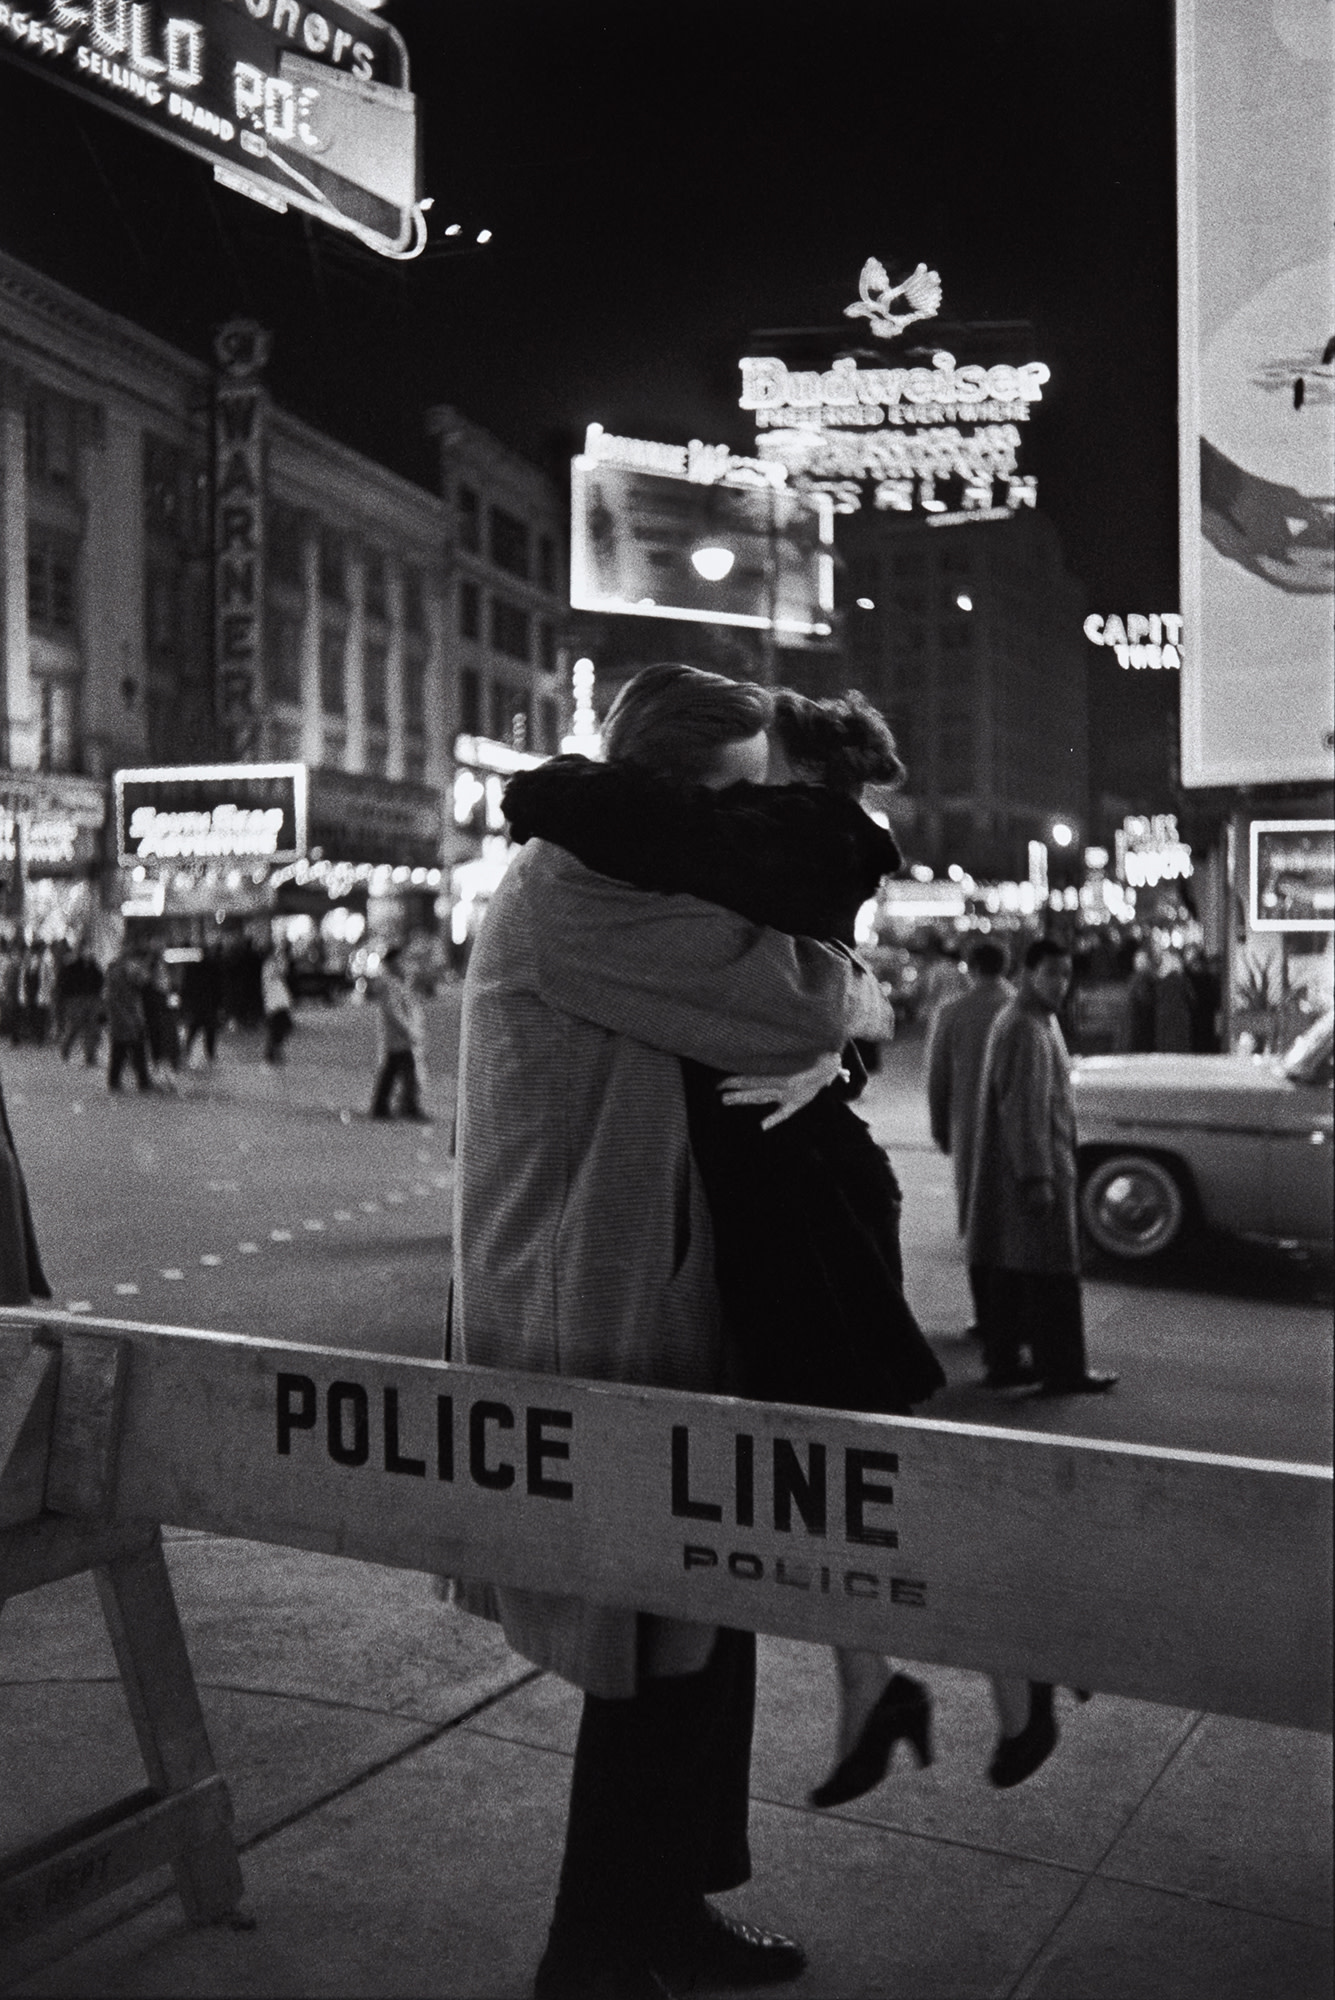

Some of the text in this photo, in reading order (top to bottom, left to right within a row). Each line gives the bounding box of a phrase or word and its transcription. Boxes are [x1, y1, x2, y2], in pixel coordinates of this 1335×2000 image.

[76, 45, 164, 106] SELLING
[168, 91, 235, 142] BRAND
[738, 351, 1051, 410] Budweiser
[276, 1371, 899, 1549] POLICE LINE
[683, 1543, 928, 1607] POLICE
